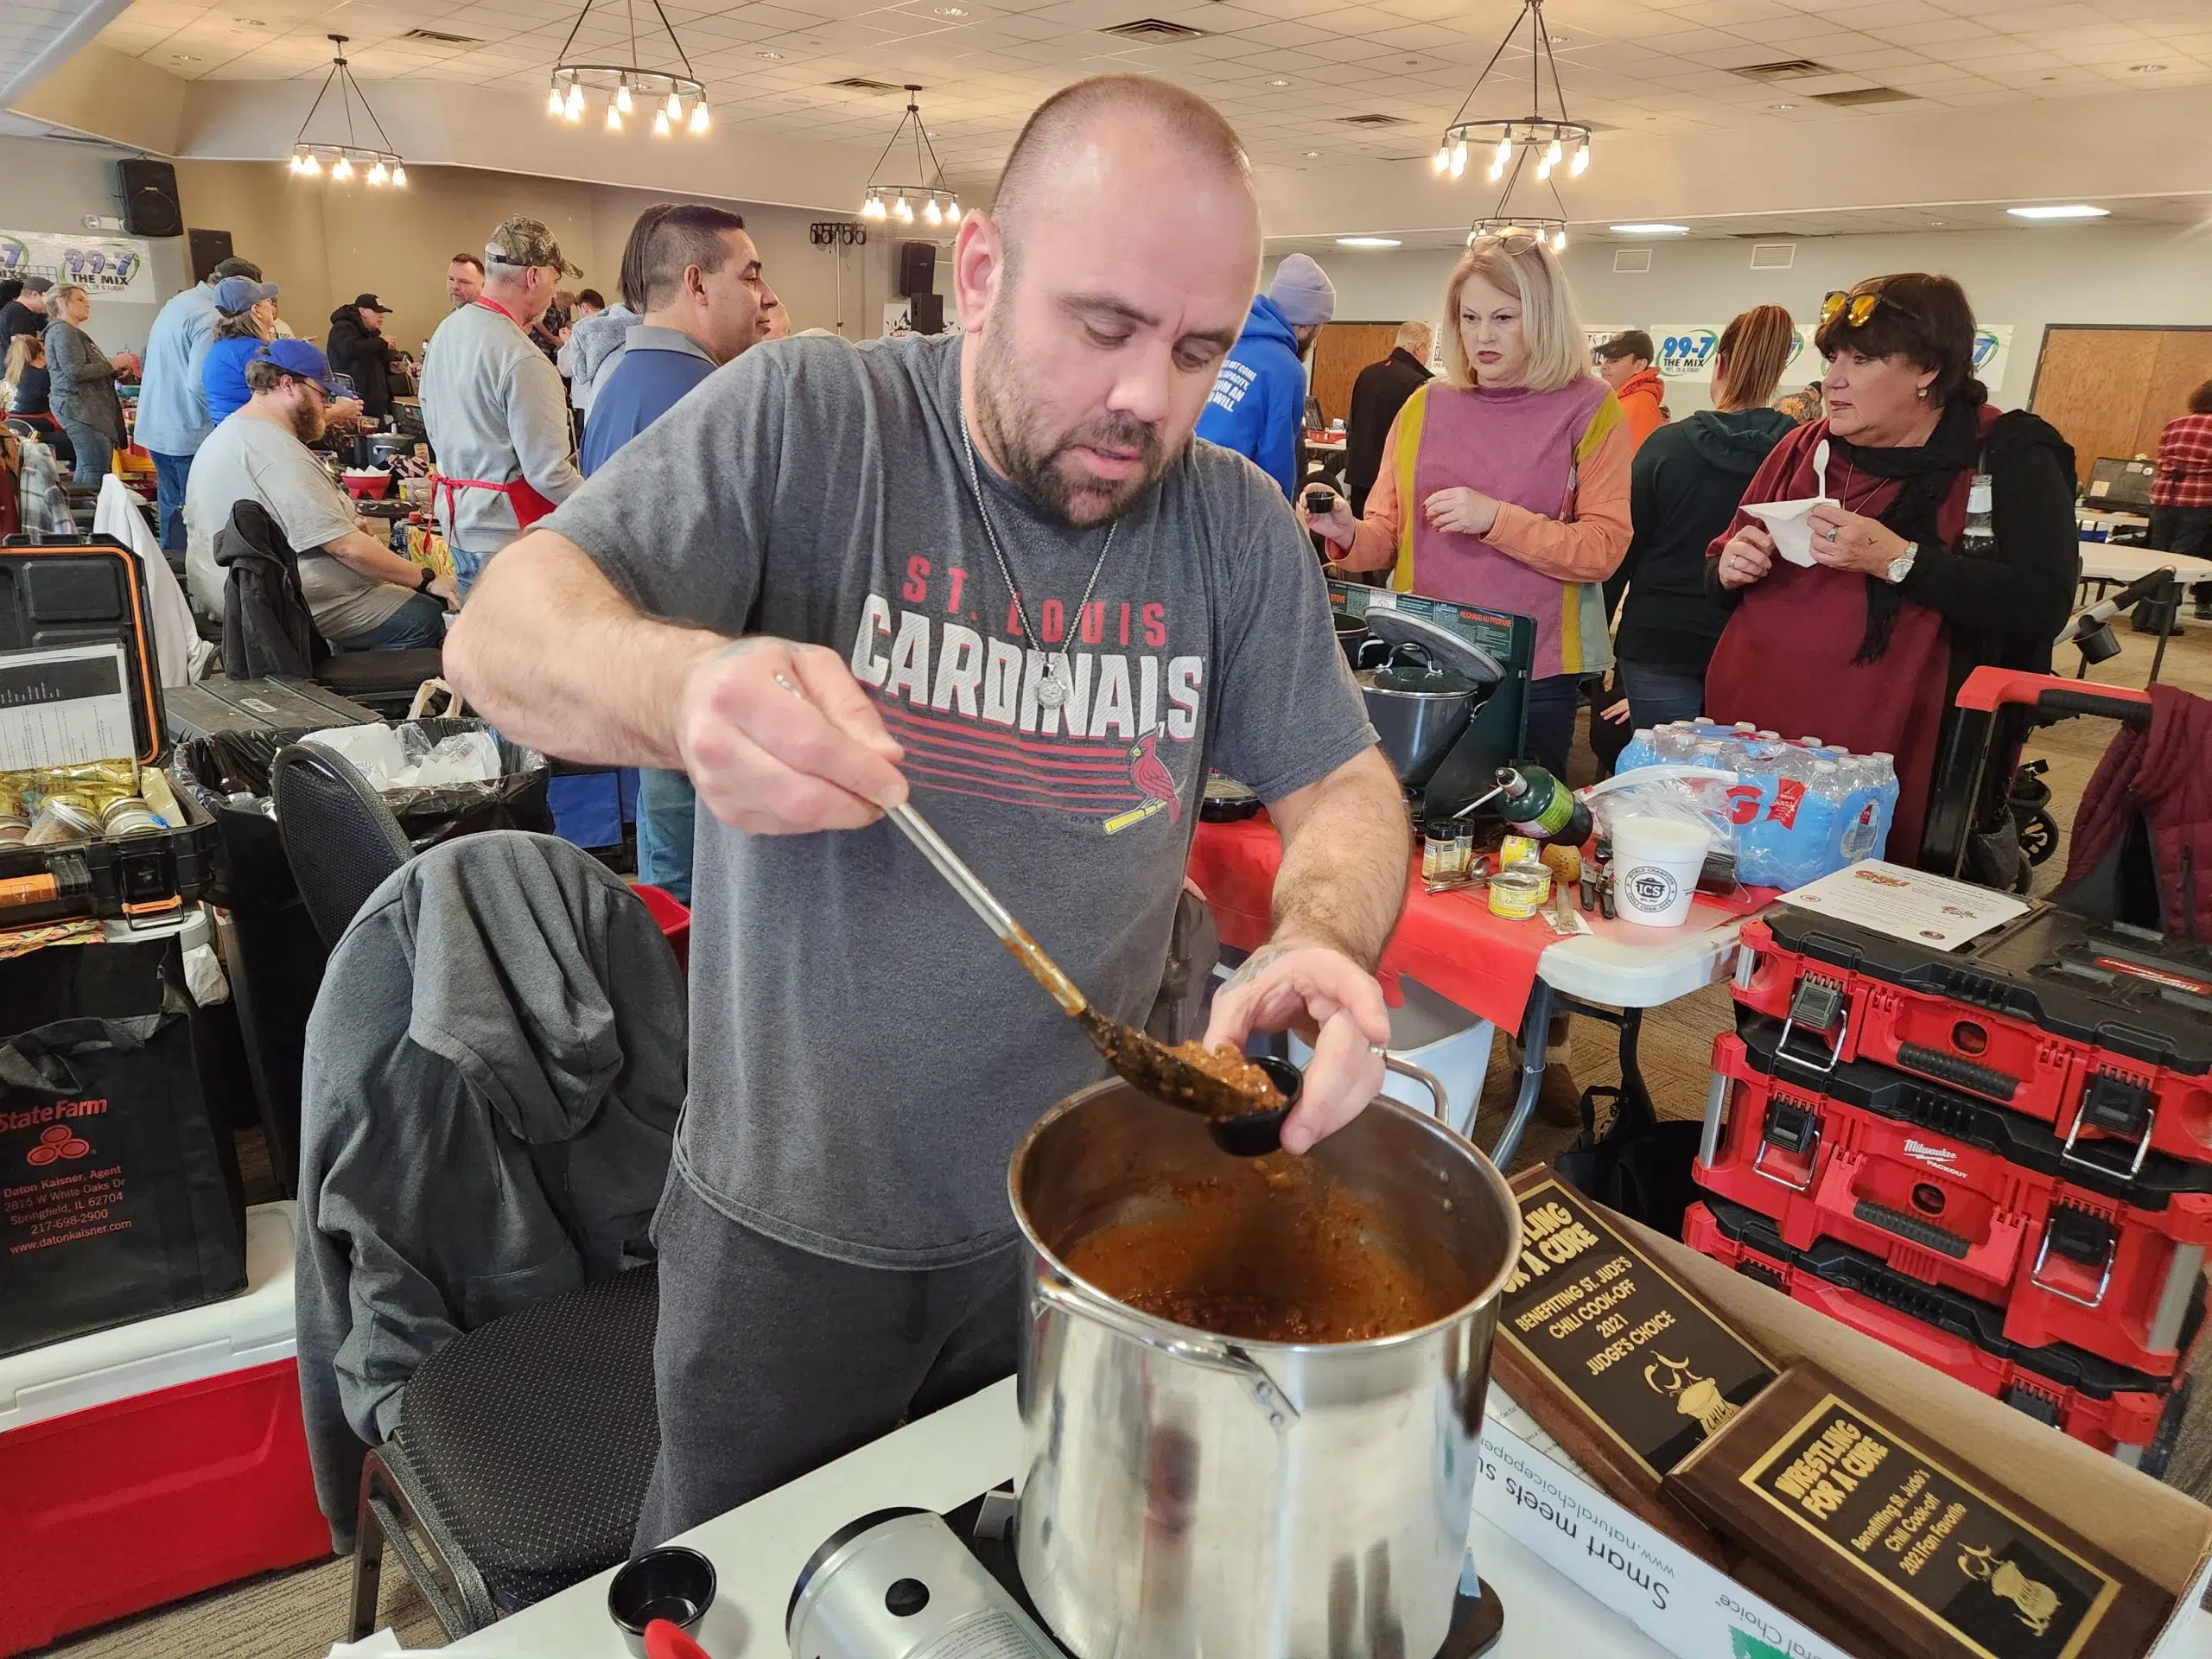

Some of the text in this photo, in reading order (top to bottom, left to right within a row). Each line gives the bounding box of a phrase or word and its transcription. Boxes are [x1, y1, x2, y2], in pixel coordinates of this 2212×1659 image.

[64, 248, 133, 276] 99-7
[70, 273, 129, 285] THE MIX
[1663, 336, 1716, 359] 99-7
[1238, 365, 1257, 381] COME
[1663, 358, 1705, 367] THE MIX
[1228, 386, 1245, 402] AN
[902, 555, 1166, 647] ST. LOUIS
[851, 593, 1203, 742] CARDINALS
[1630, 868, 1674, 886] WORLD CHAMPION
[1639, 884, 1661, 897] ICS
[1627, 893, 1673, 912] CHILI COOK-OFFS
[1904, 1138, 1957, 1159] Milwaukee
[3, 1165, 121, 1198] Daton Kaisner, Agent
[1927, 1160, 1968, 1179] PACKOUT
[36, 1194, 48, 1205] W
[50, 1189, 80, 1202] White
[83, 1182, 110, 1194] Oaks
[112, 1178, 125, 1188] Dr
[10, 1192, 124, 1225] Springfield, IL 62704
[30, 1209, 109, 1235] 217-698-2900
[10, 1219, 132, 1255] www.datonkaisner.com
[1521, 1249, 1551, 1276] A
[1538, 1221, 1599, 1264] CURE
[1514, 1255, 1632, 1332] BENEFITTING ST. JUDE'S
[1548, 1278, 1637, 1339] CHILI COOK-OFF
[1595, 1313, 1629, 1338] 2021
[1586, 1310, 1676, 1376] JUDGE'S CHOICE
[1774, 1419, 1861, 1499] WRESTLING
[1801, 1434, 1888, 1521] FOR A CURE
[1899, 1469, 1930, 1498] Jude's
[1506, 1478, 1577, 1538] meets
[1889, 1493, 1910, 1508] St.
[1884, 1491, 1941, 1552] Chili Cook-off
[1929, 1503, 1967, 1538] Favorite
[1586, 1535, 1669, 1610] Smart
